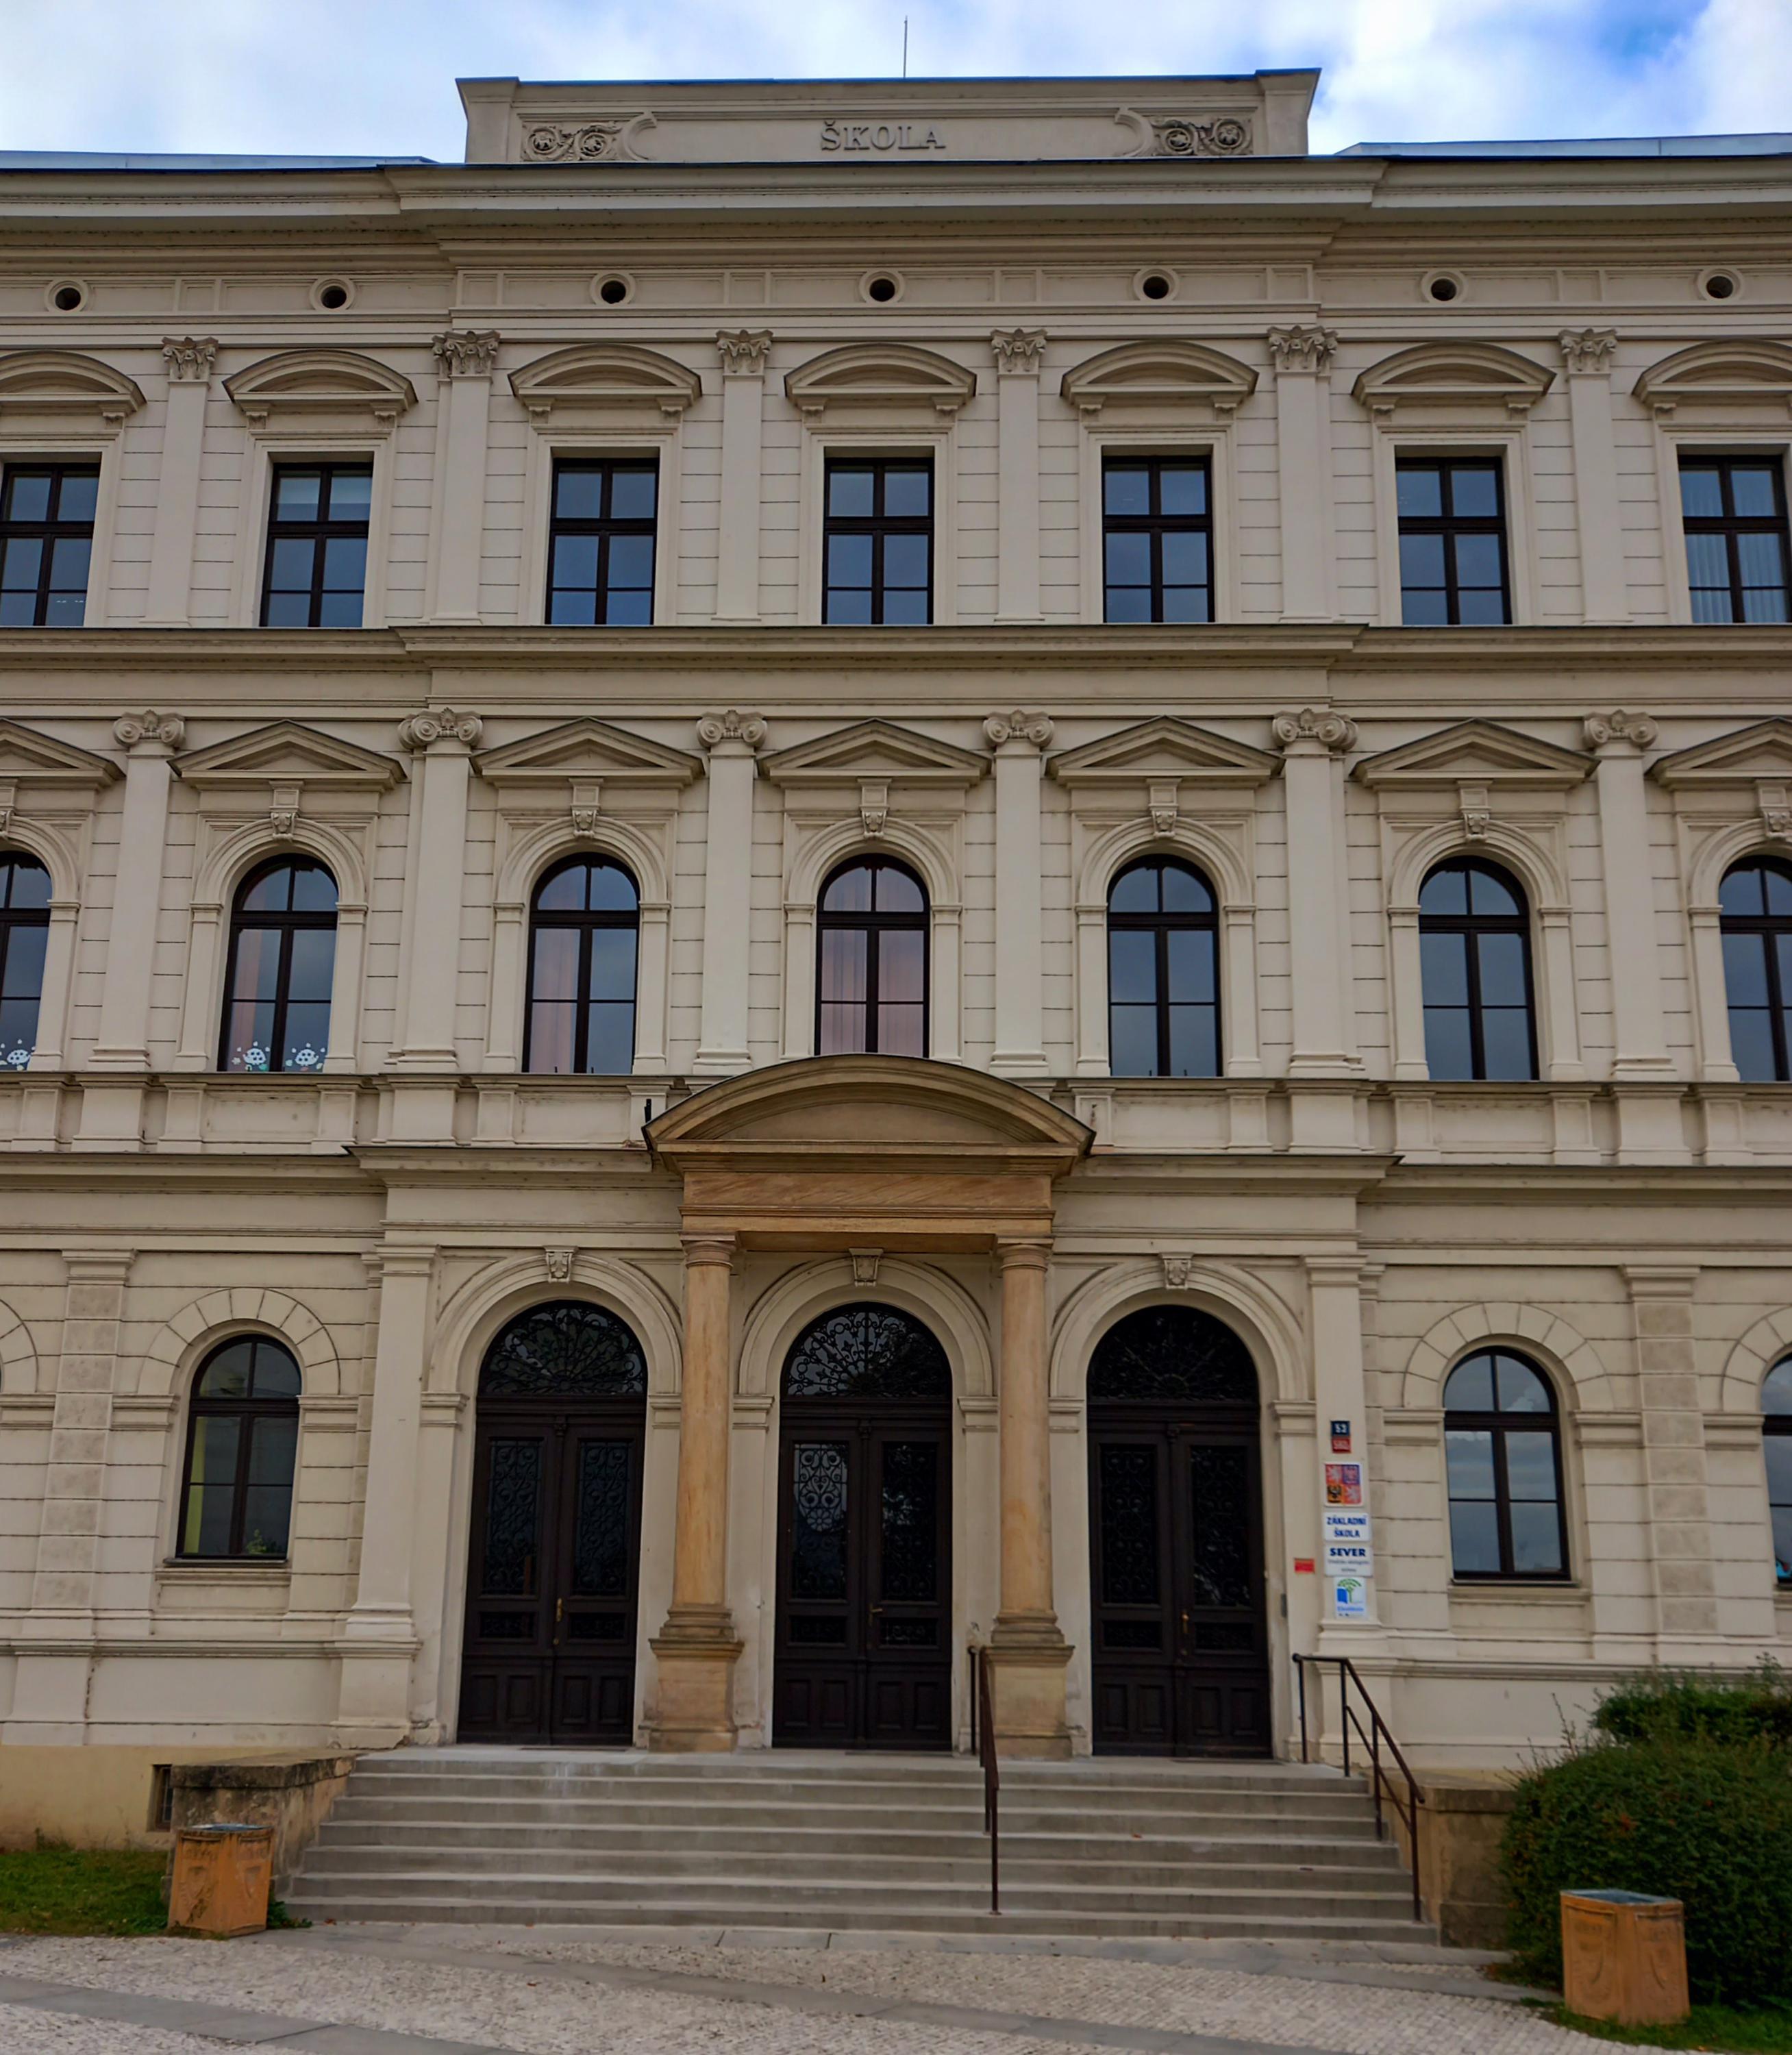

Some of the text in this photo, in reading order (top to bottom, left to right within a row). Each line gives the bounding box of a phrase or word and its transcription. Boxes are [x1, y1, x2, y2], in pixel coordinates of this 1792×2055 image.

[821, 119, 947, 151] ŠKOLA
[1327, 1515, 1367, 1525] ZÁKLADNÍ
[1334, 1528, 1360, 1537] ŠKOLA
[1330, 1547, 1366, 1557] SEVER
